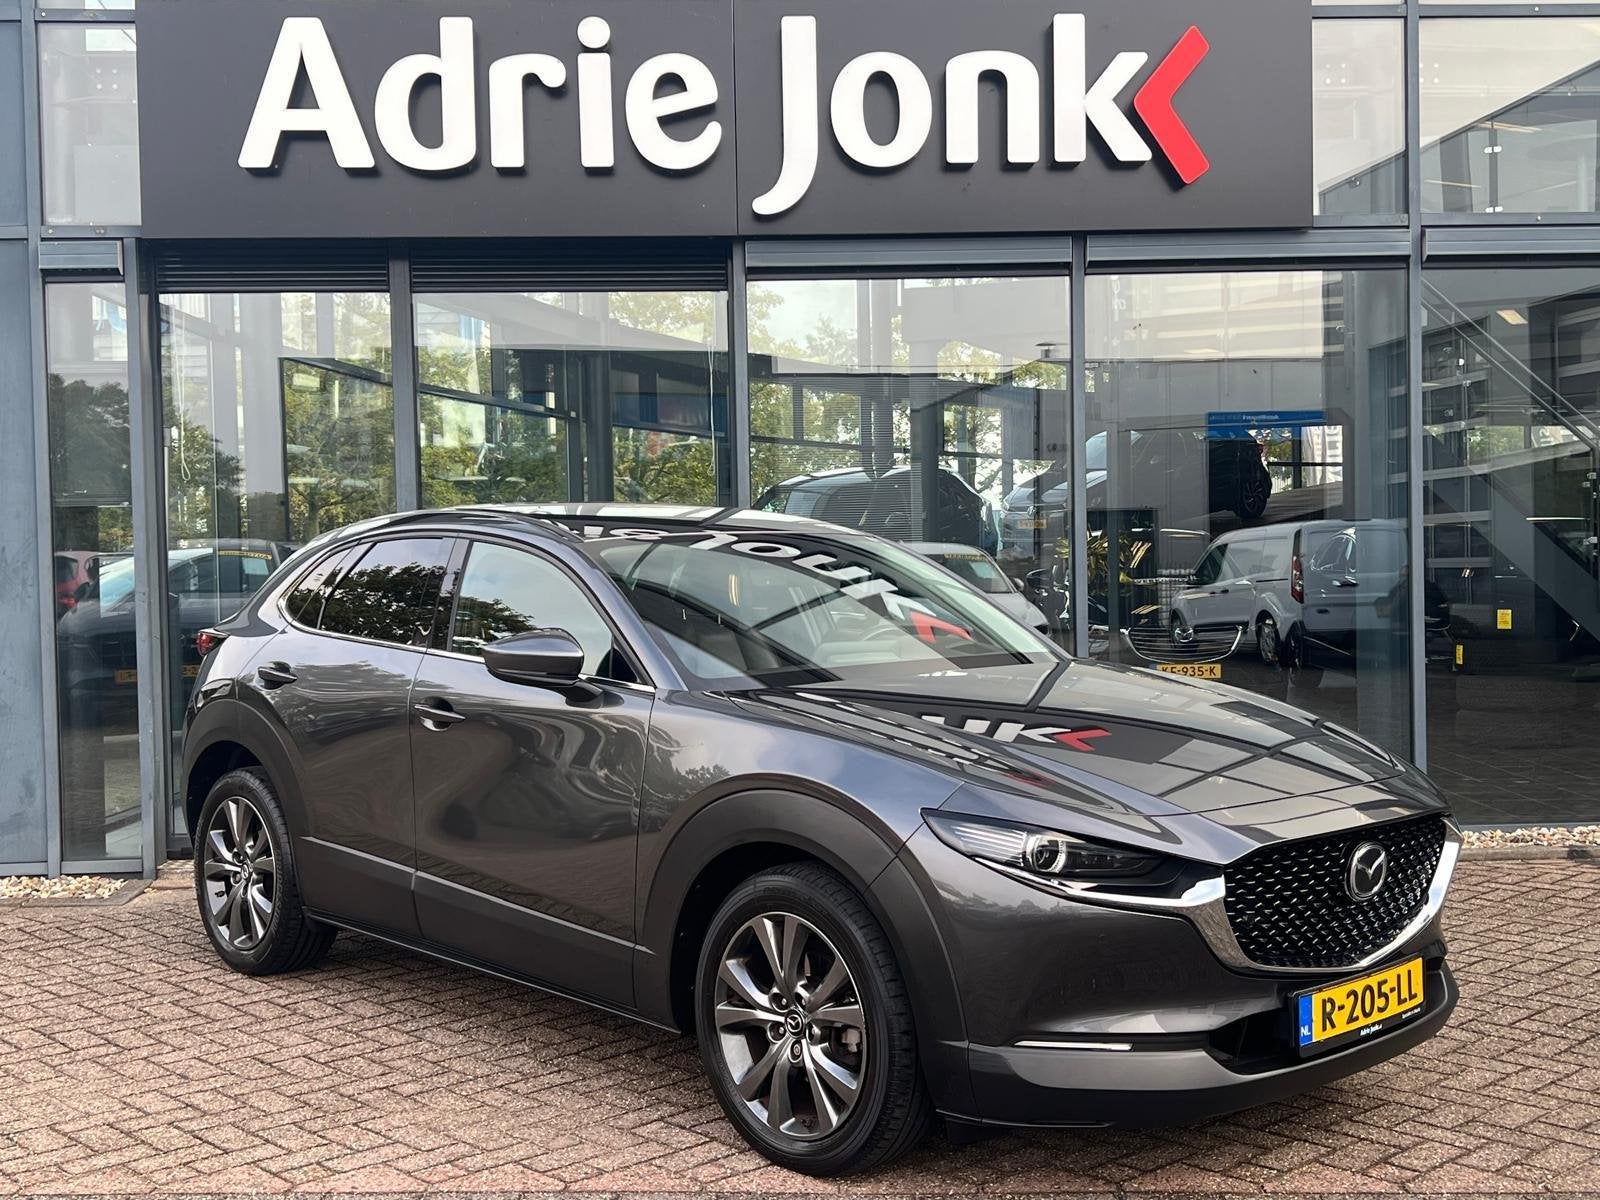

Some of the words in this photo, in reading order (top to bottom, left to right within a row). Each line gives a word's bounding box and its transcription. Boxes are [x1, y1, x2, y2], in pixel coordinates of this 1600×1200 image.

[237, 15, 723, 173] Adrie
[751, 12, 1153, 217] Jonk
[1300, 1025, 1311, 1037] NL
[1321, 969, 1418, 1033] R-205-LL
